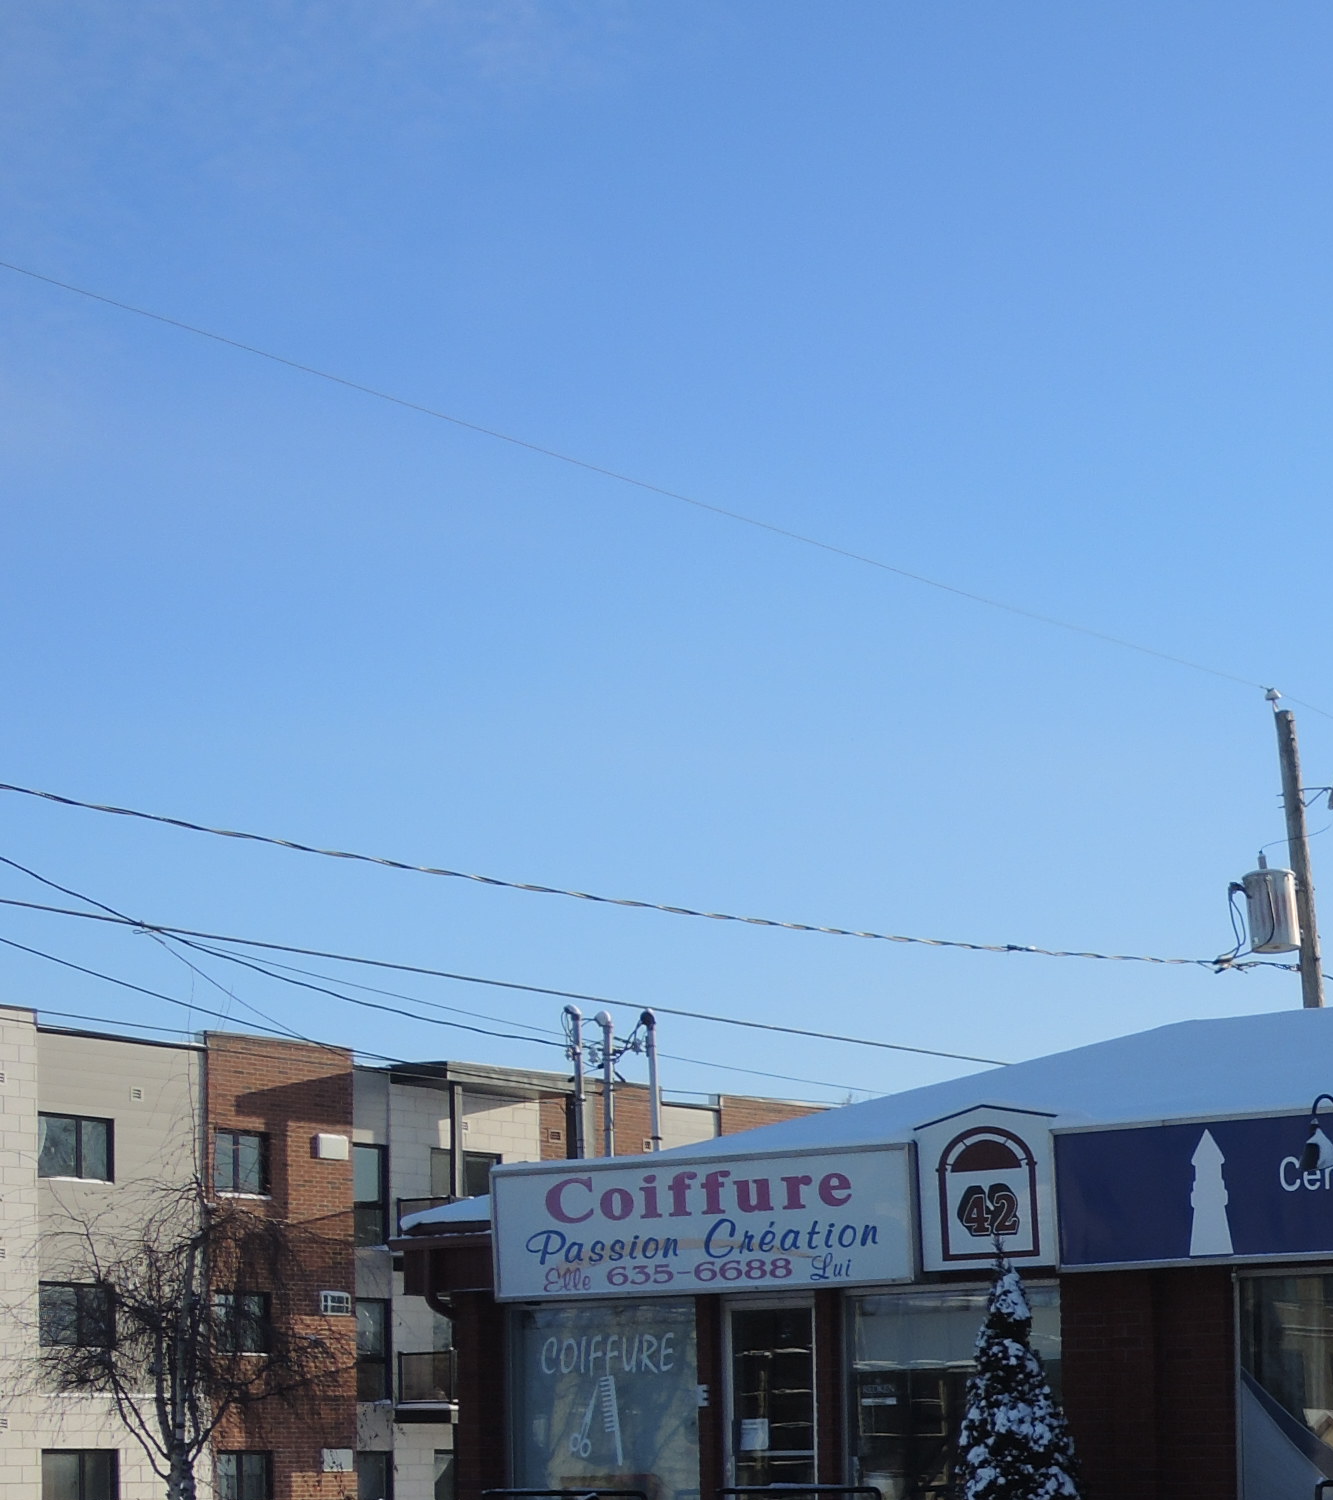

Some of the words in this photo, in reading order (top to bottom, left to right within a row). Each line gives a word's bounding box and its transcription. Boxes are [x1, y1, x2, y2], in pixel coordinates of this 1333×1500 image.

[545, 1170, 853, 1223] Coiffure
[957, 1183, 1020, 1237] 42
[526, 1229, 679, 1265] Passion
[704, 1218, 879, 1258] Création
[543, 1266, 592, 1293] Elle
[606, 1257, 793, 1287] 635-6688
[809, 1252, 852, 1281] Lui
[541, 1332, 675, 1376] COIFFURE
